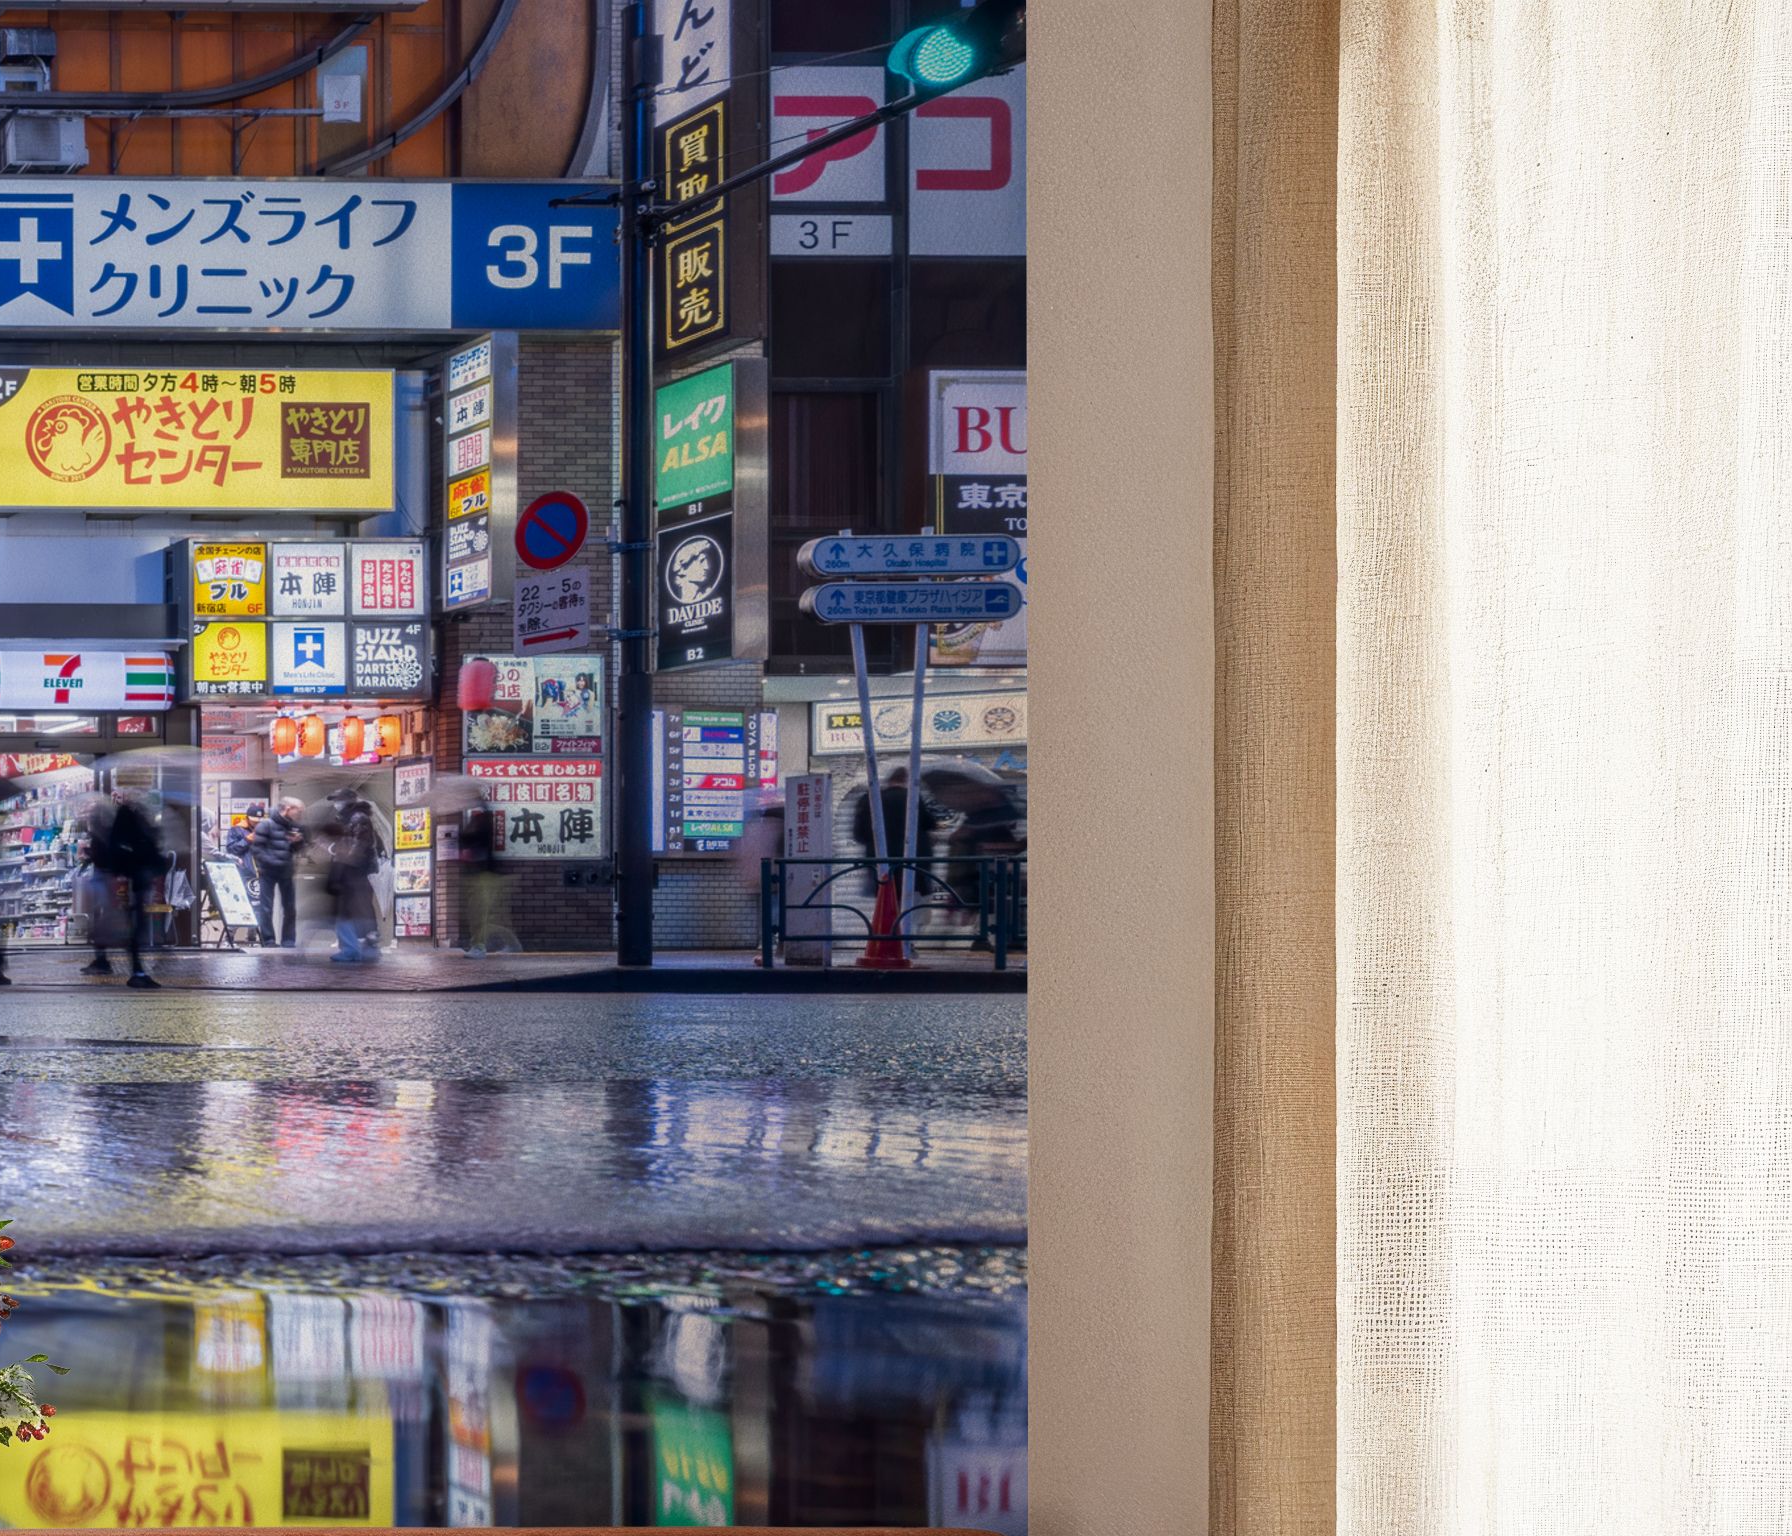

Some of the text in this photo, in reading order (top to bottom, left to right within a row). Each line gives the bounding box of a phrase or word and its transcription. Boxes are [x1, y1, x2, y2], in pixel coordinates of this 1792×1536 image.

[89, 192, 417, 247] メンズライフ
[798, 220, 854, 250] 3F
[486, 225, 593, 290] 3F
[89, 264, 356, 318] クリニック
[676, 242, 713, 332] 販売
[80, 374, 139, 392] 営業時間
[111, 395, 255, 442] やきとり
[286, 406, 365, 435] やきとり
[663, 394, 727, 440] レイク
[290, 438, 360, 466] 専門店
[662, 431, 728, 473] ALSA
[116, 440, 263, 488] センター
[330, 467, 360, 475] CENTER
[957, 483, 1027, 509] 東京
[688, 502, 703, 515] B1
[197, 546, 262, 555] 全国チェーンの店
[857, 541, 976, 559] 大久保病院
[215, 558, 245, 576] 麻雀
[825, 558, 948, 569] 260m Okubo Hospital
[211, 583, 249, 600] ブル
[280, 571, 337, 596] 本陣
[380, 561, 395, 608] たこ焼き
[292, 598, 323, 609] HONJIN
[854, 589, 983, 605] 東京都健康プラザハイジア
[196, 602, 263, 614] 新宿店 6F
[668, 597, 723, 624] DAVIDE
[854, 605, 880, 616] Tokyo
[930, 605, 953, 615] Plaza
[356, 628, 402, 645] BUZZ
[406, 624, 421, 634] 4F
[209, 651, 248, 663] やきとり
[356, 644, 417, 662] STAND
[686, 647, 704, 661] B2
[210, 663, 250, 676] センター
[43, 654, 81, 704] 7
[196, 682, 264, 694] 朝まで営業中
[509, 807, 595, 844] 本陣
[796, 782, 809, 854] 駐停車禁止
